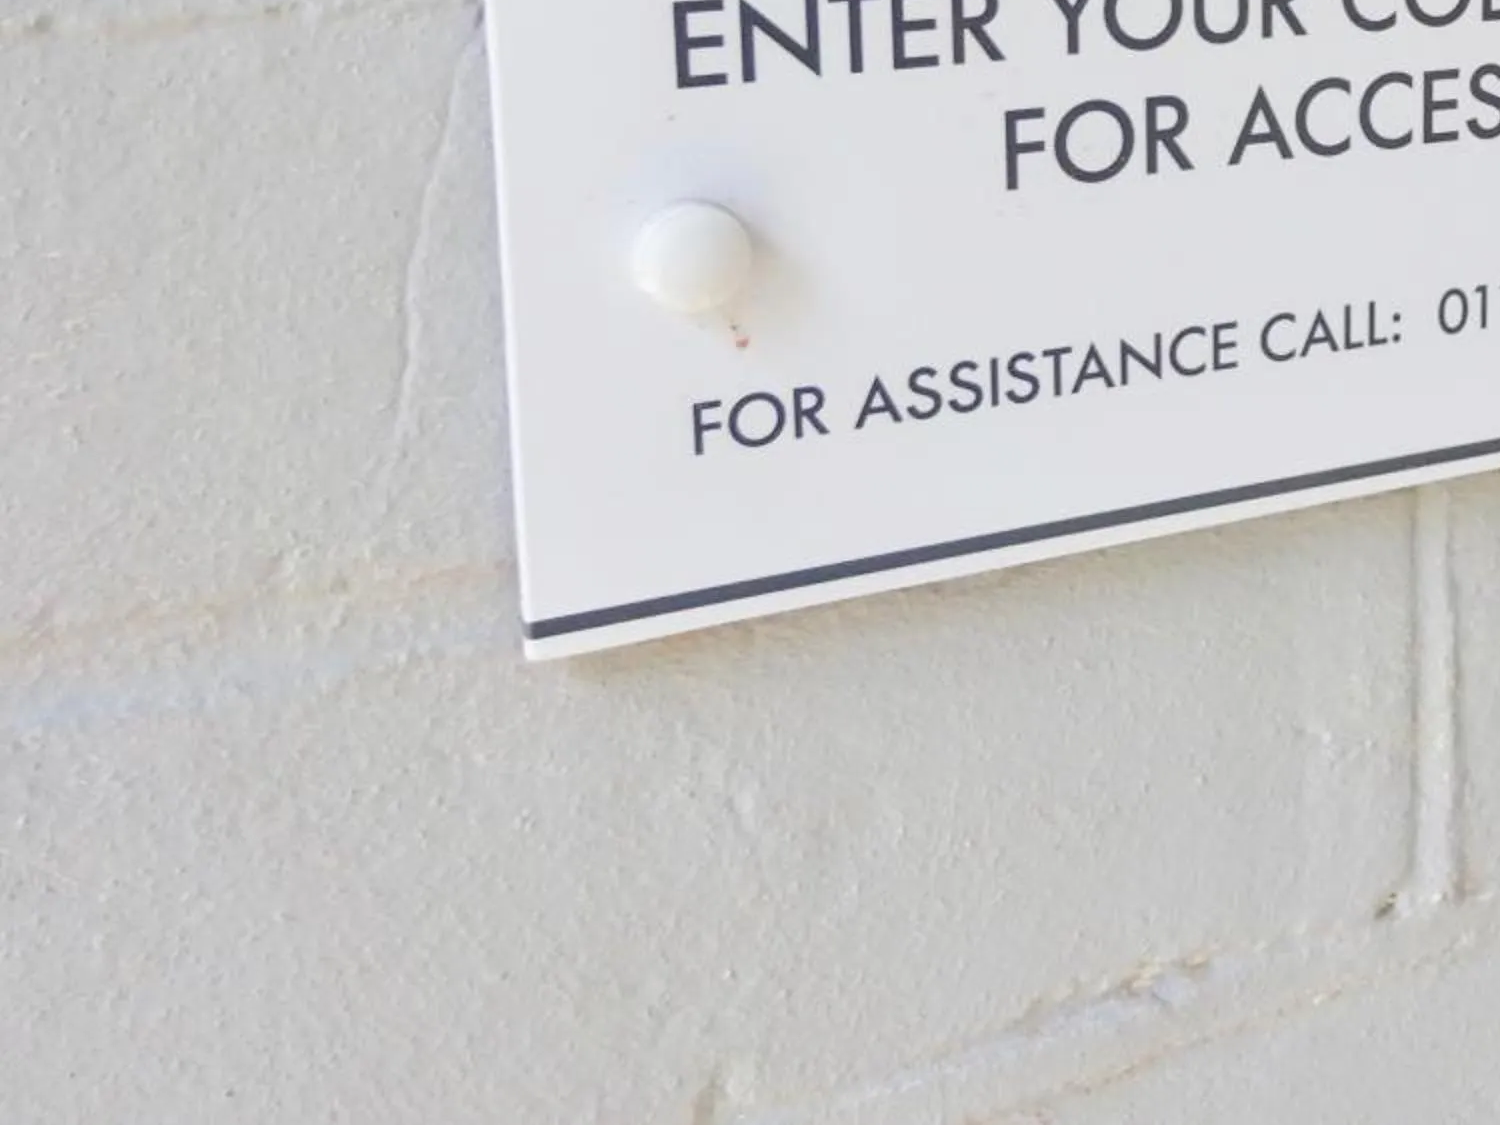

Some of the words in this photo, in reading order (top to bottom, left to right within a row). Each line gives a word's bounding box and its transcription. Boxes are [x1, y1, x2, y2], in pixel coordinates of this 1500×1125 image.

[1003, 94, 1195, 192] FOR
[691, 385, 831, 457] FOR
[853, 320, 1239, 431] ASSISTANCE
[1259, 300, 1402, 363] CALL:
